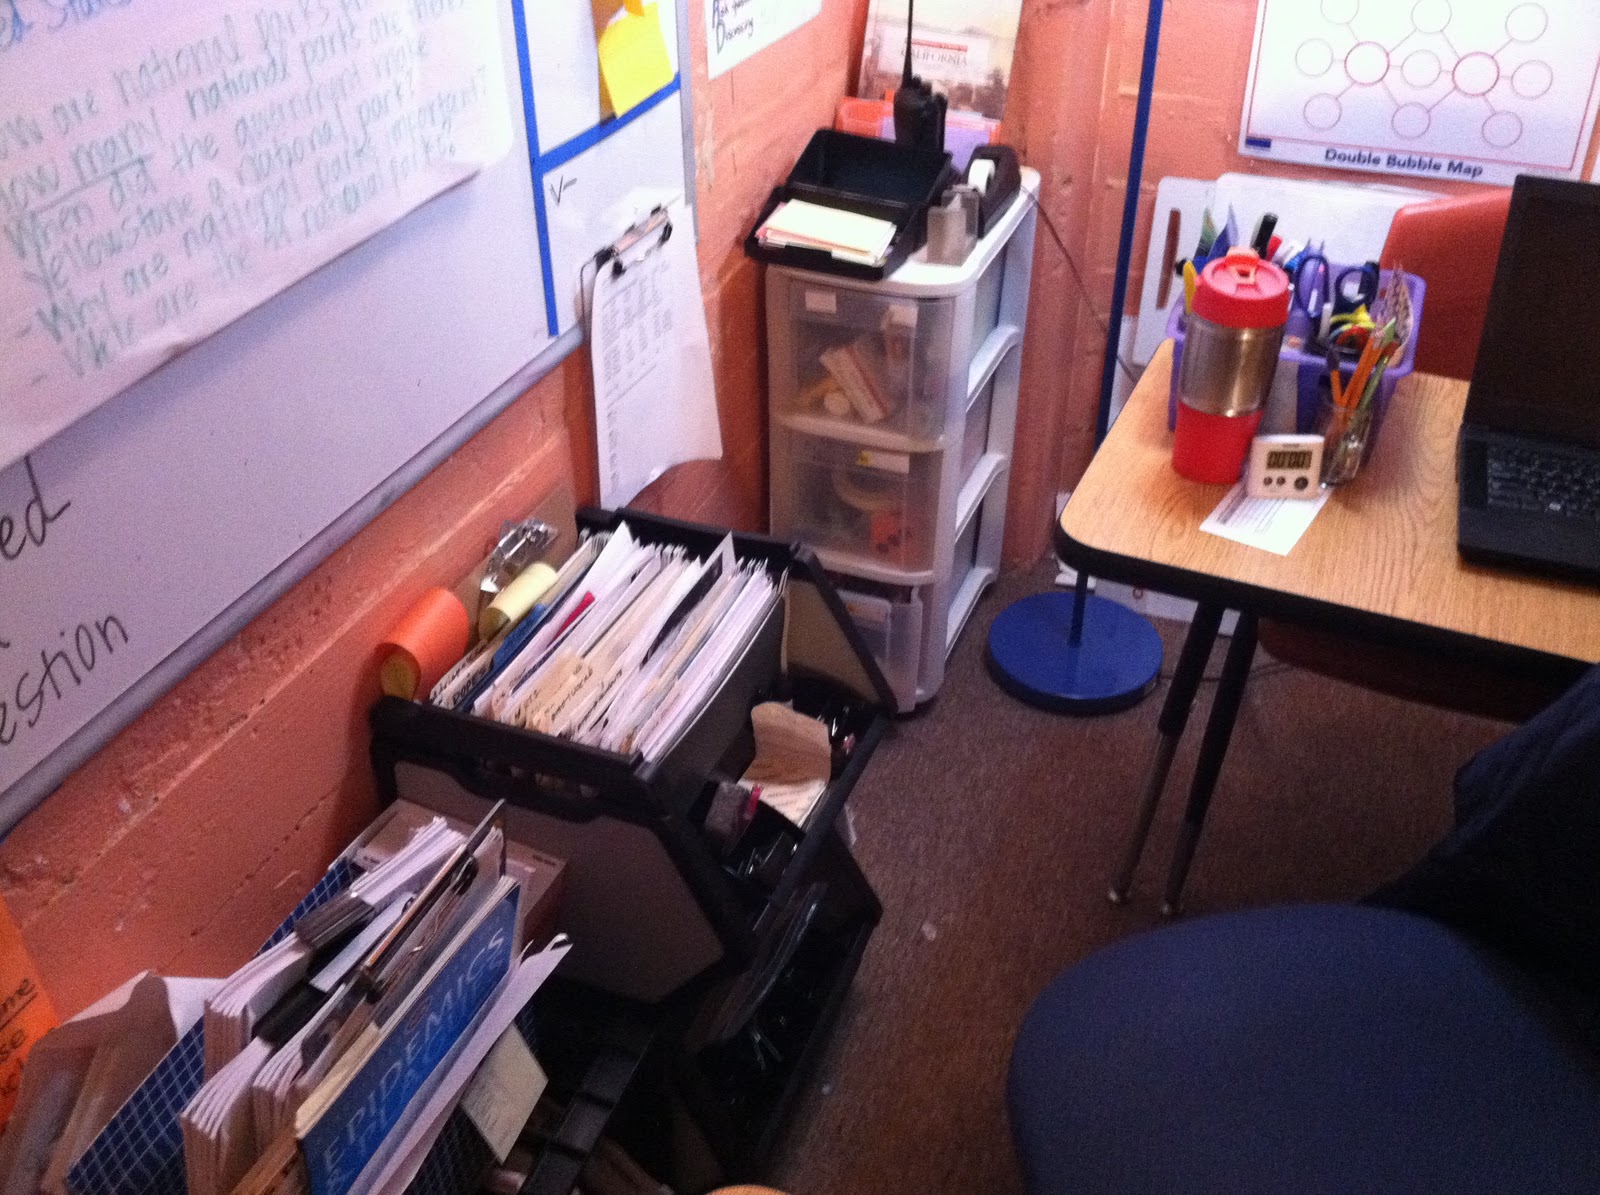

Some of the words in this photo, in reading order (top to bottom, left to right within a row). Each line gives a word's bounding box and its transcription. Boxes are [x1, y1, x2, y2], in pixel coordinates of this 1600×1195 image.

[1325, 148, 1381, 167] Double
[1386, 154, 1442, 174] Bubble
[1446, 161, 1484, 179] Map
[322, 928, 505, 1173] EPIDEMICS
